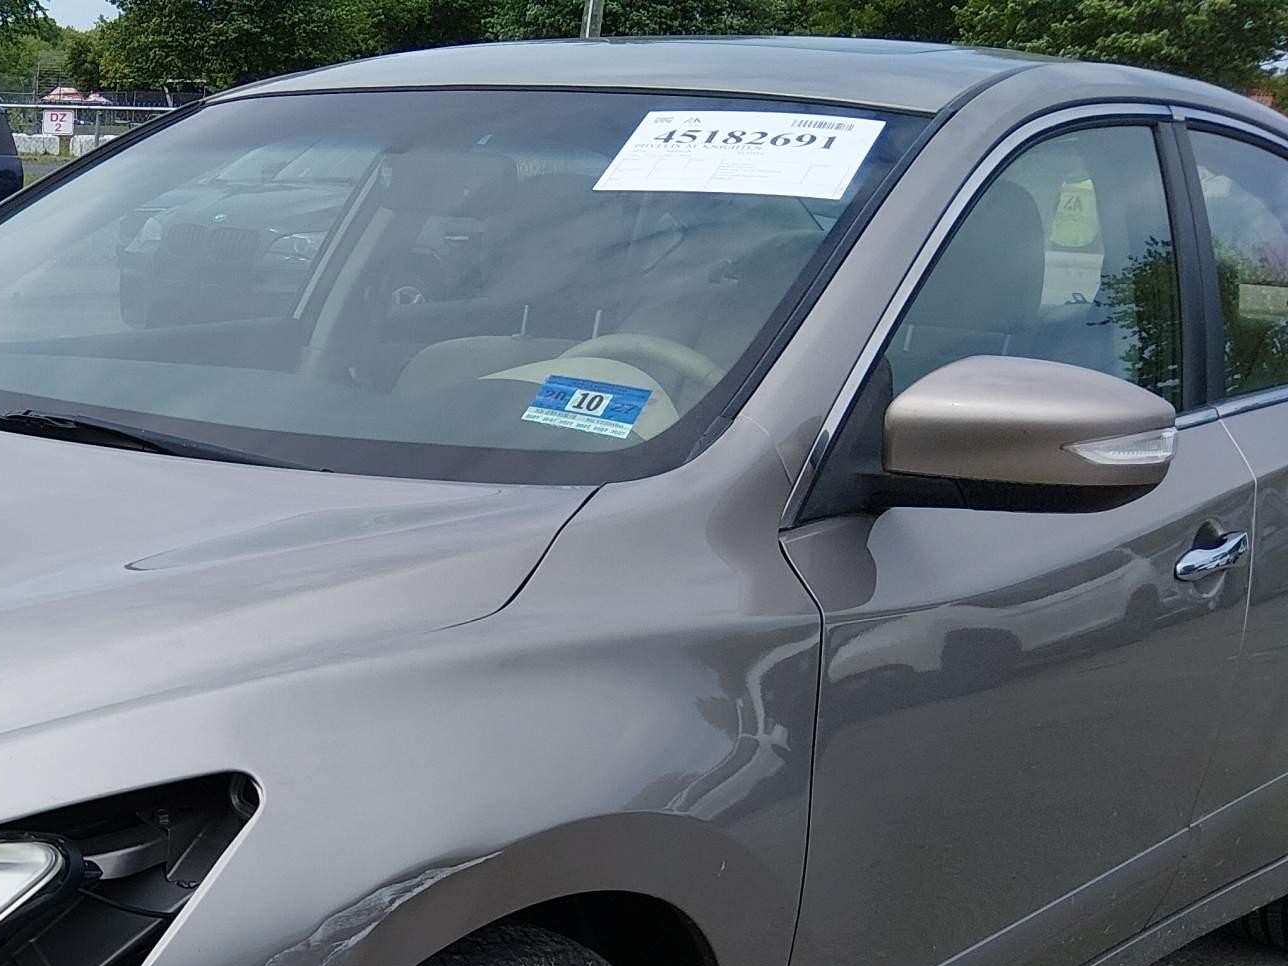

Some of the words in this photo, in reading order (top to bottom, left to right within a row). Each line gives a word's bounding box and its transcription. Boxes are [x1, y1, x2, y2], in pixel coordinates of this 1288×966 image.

[50, 113, 67, 122] DZ
[55, 123, 62, 131] 2
[654, 129, 837, 149] 45182691
[571, 392, 604, 412] 10
[611, 403, 637, 414] 27
